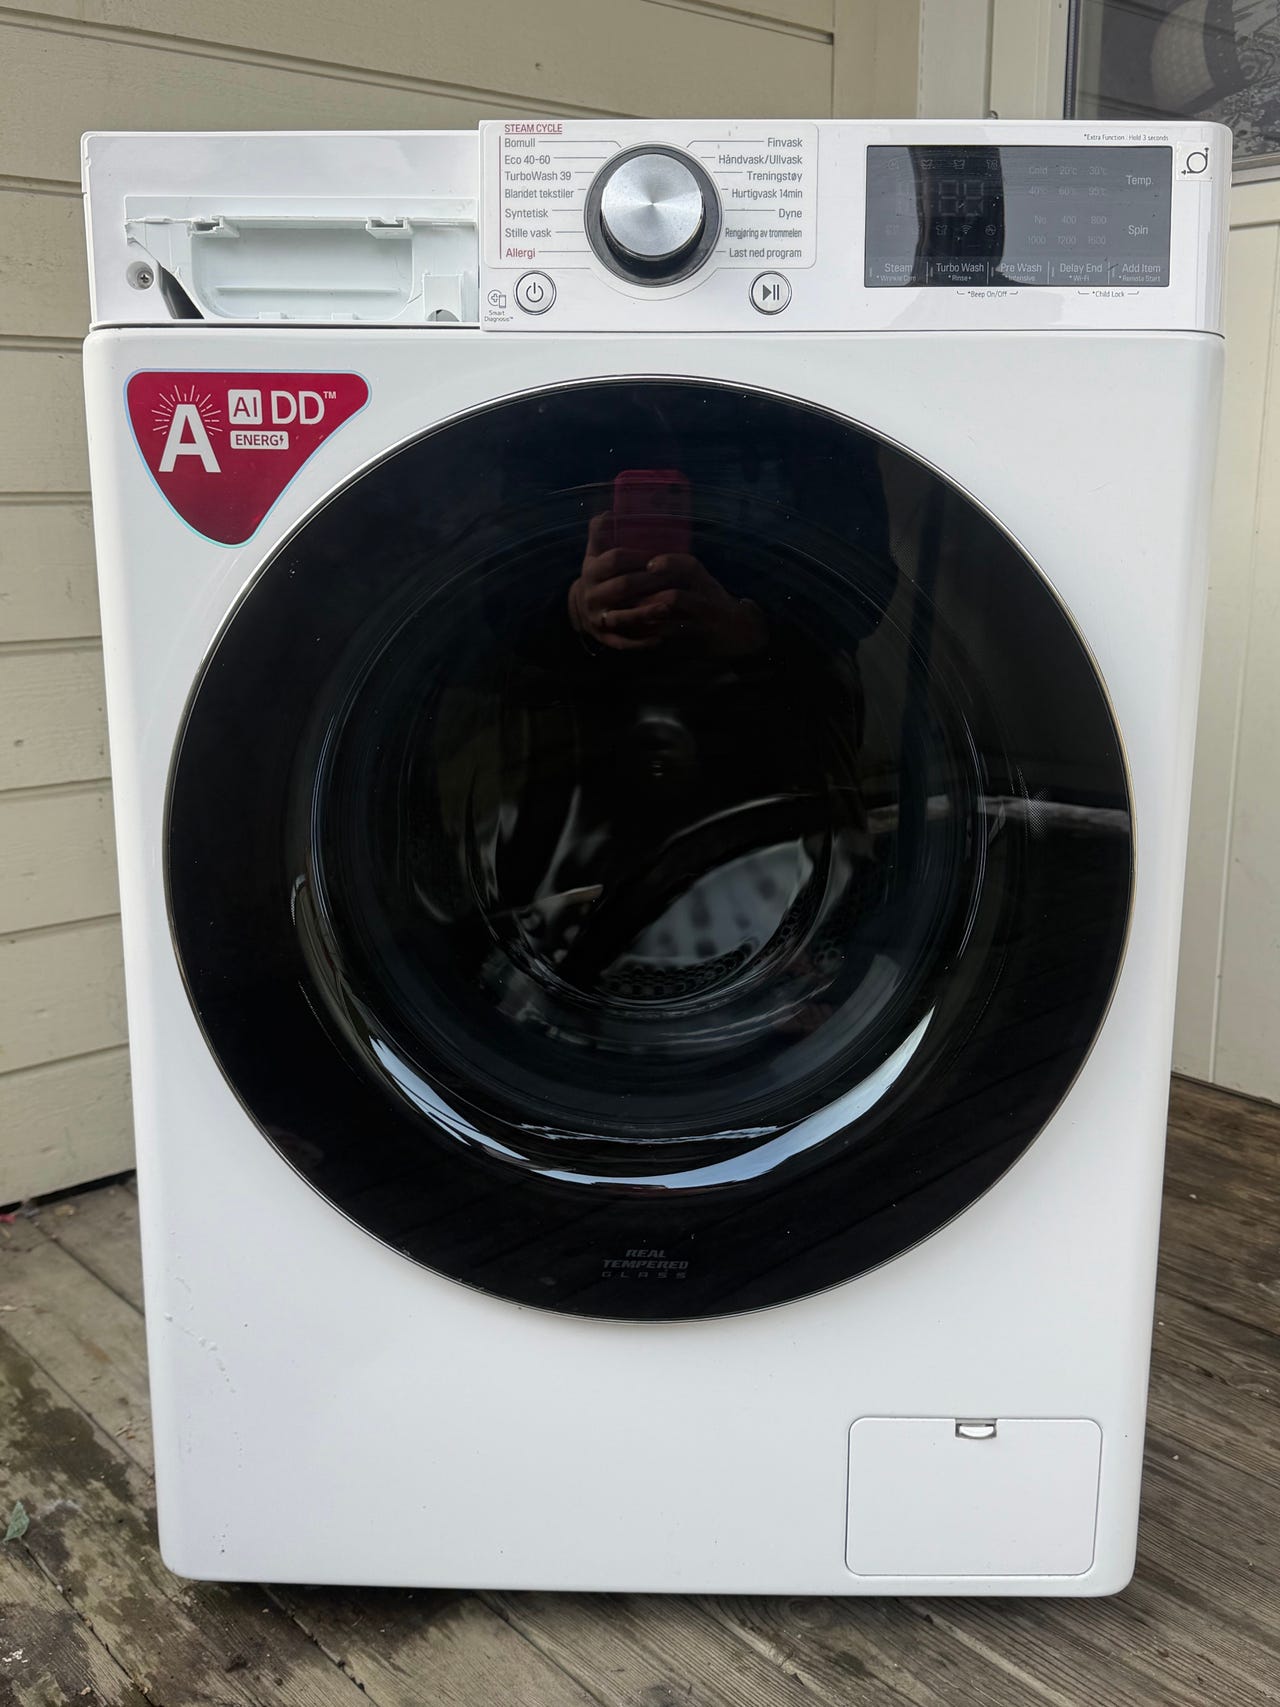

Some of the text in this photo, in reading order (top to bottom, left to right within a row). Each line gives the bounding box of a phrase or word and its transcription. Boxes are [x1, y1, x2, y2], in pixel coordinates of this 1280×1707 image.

[504, 123, 563, 132] STEAM CYCLE
[504, 137, 536, 148] Bomull
[767, 137, 803, 148] Finvask
[1142, 133, 1147, 141] 3
[504, 154, 551, 165] Eco 40-60
[718, 153, 803, 165] Håndvask/Ullvask
[504, 171, 572, 181] TurboWash 39
[746, 170, 803, 183] Treningstøy
[1125, 174, 1155, 188] Temp.
[504, 188, 575, 199] Blandet tekstiler
[731, 188, 803, 200] Hurtigvask 14min
[504, 207, 549, 220] Syntetisk
[778, 207, 803, 220] Dyne
[504, 227, 552, 238] Stille vask
[725, 227, 803, 239] Rengjøring av trommelen
[1128, 224, 1149, 237] Spin
[505, 247, 536, 260] Allergi
[729, 248, 803, 260] Last ned program
[884, 262, 913, 273] Steam
[935, 262, 984, 273] Turbo Wash
[1000, 262, 1043, 273] Pre Wash
[1059, 262, 1103, 274] Delay End
[1121, 262, 1161, 273] Add Item
[986, 290, 1008, 298] On/Off
[1111, 290, 1125, 298] Lock
[232, 395, 260, 419] AI
[158, 403, 222, 473] A
[625, 1249, 666, 1258] REAL
[601, 1259, 689, 1270] TEMPERED
